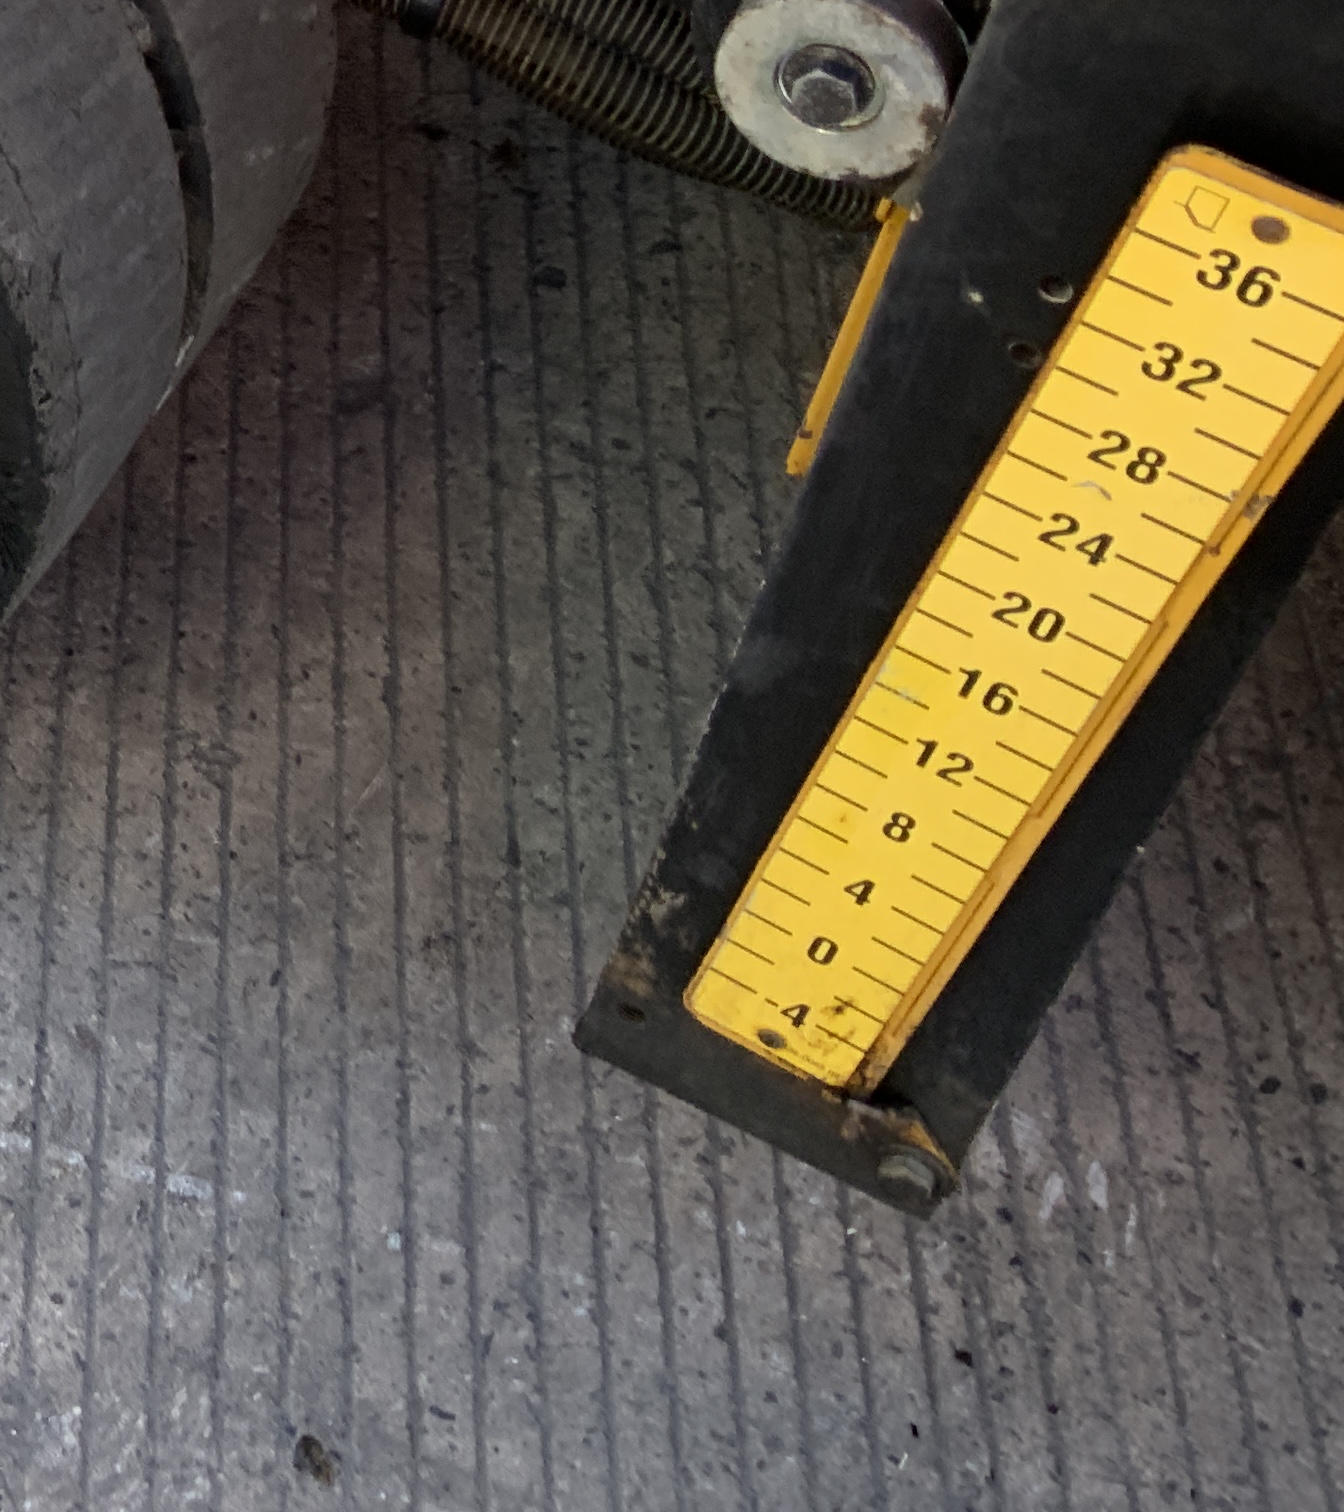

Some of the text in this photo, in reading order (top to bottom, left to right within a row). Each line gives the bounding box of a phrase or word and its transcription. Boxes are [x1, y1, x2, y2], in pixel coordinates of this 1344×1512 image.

[1196, 249, 1281, 308] 36
[1141, 342, 1222, 400] 32
[1087, 430, 1167, 484] 28
[1038, 513, 1114, 566] 24
[991, 591, 1066, 643] 20
[958, 668, 1018, 716] 16
[916, 739, 974, 786] 12
[882, 812, 917, 844] 8
[844, 879, 876, 907] 4
[807, 936, 839, 966] 0
